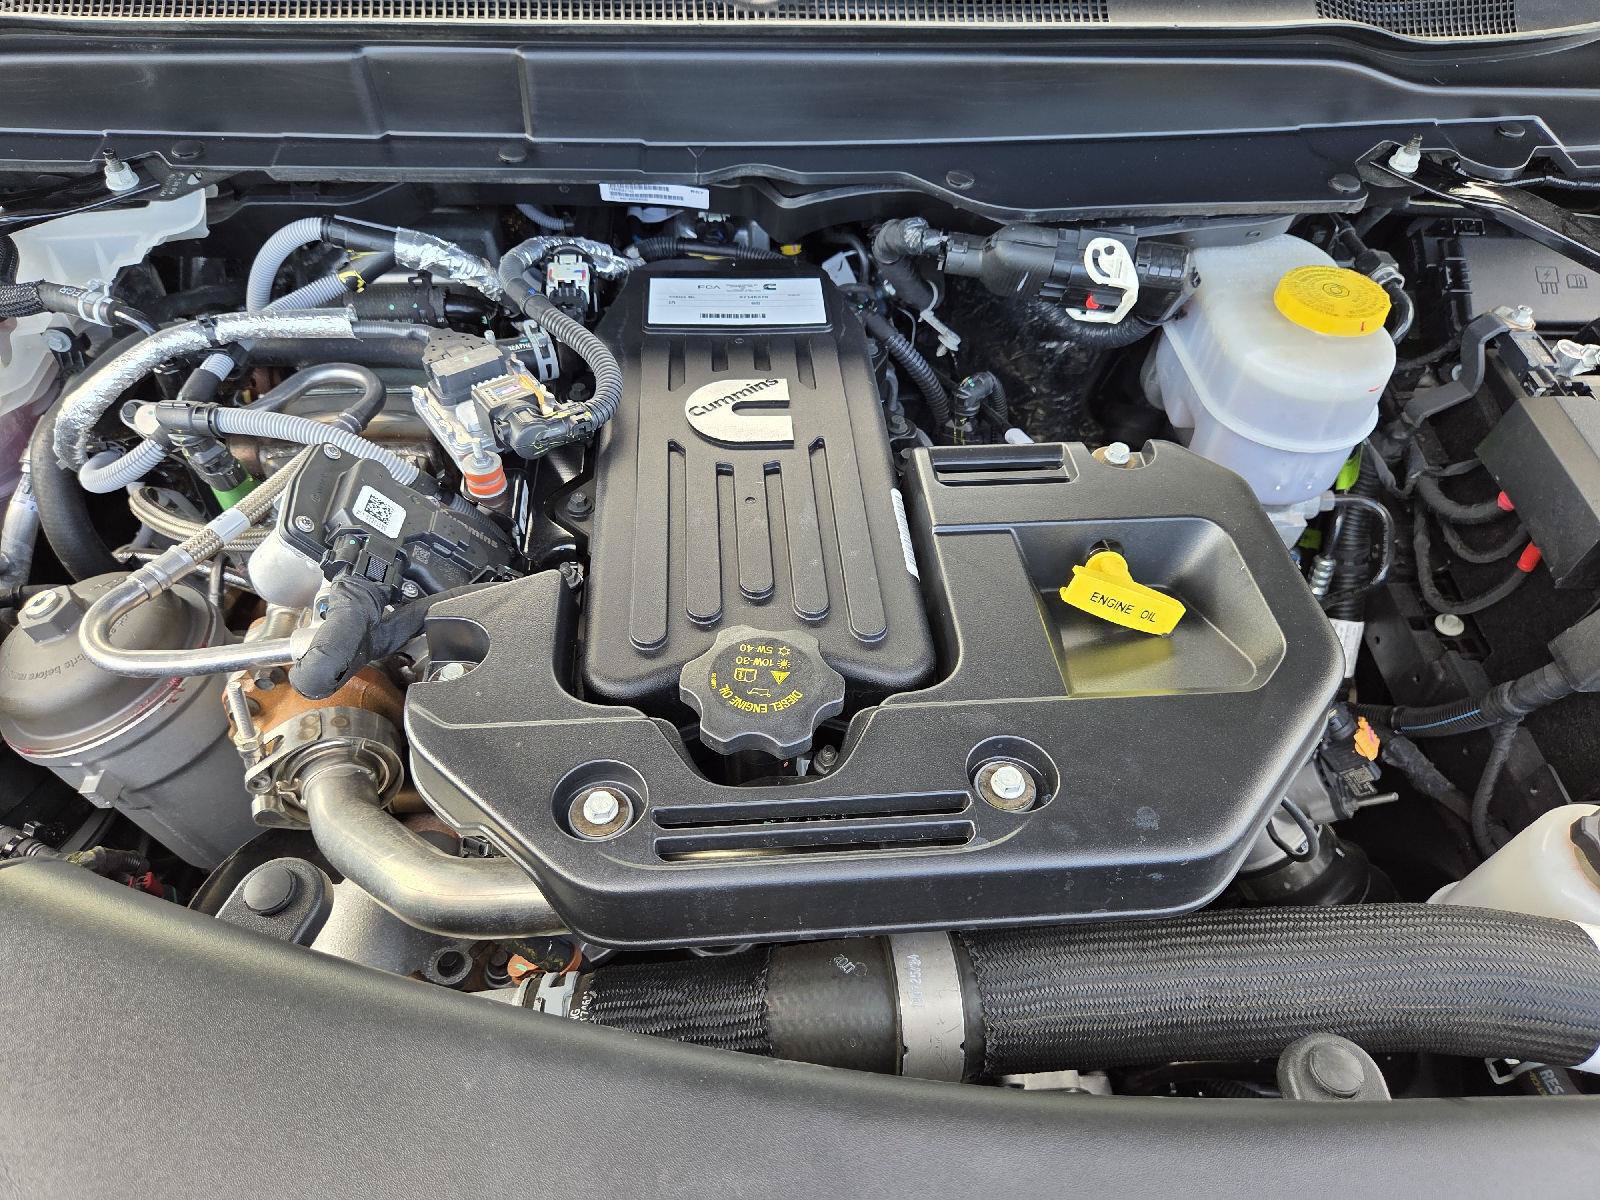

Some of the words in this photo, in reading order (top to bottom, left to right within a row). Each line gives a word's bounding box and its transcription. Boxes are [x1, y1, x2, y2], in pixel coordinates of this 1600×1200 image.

[688, 379, 779, 416] Cummins
[1089, 591, 1135, 615] ENGINE
[1140, 610, 1157, 623] OIL
[740, 643, 774, 654] 5W-40
[735, 656, 774, 667] 10W-30
[719, 684, 734, 699] OIL
[769, 689, 804, 712] DIESEL
[729, 695, 769, 714] ENGINE
